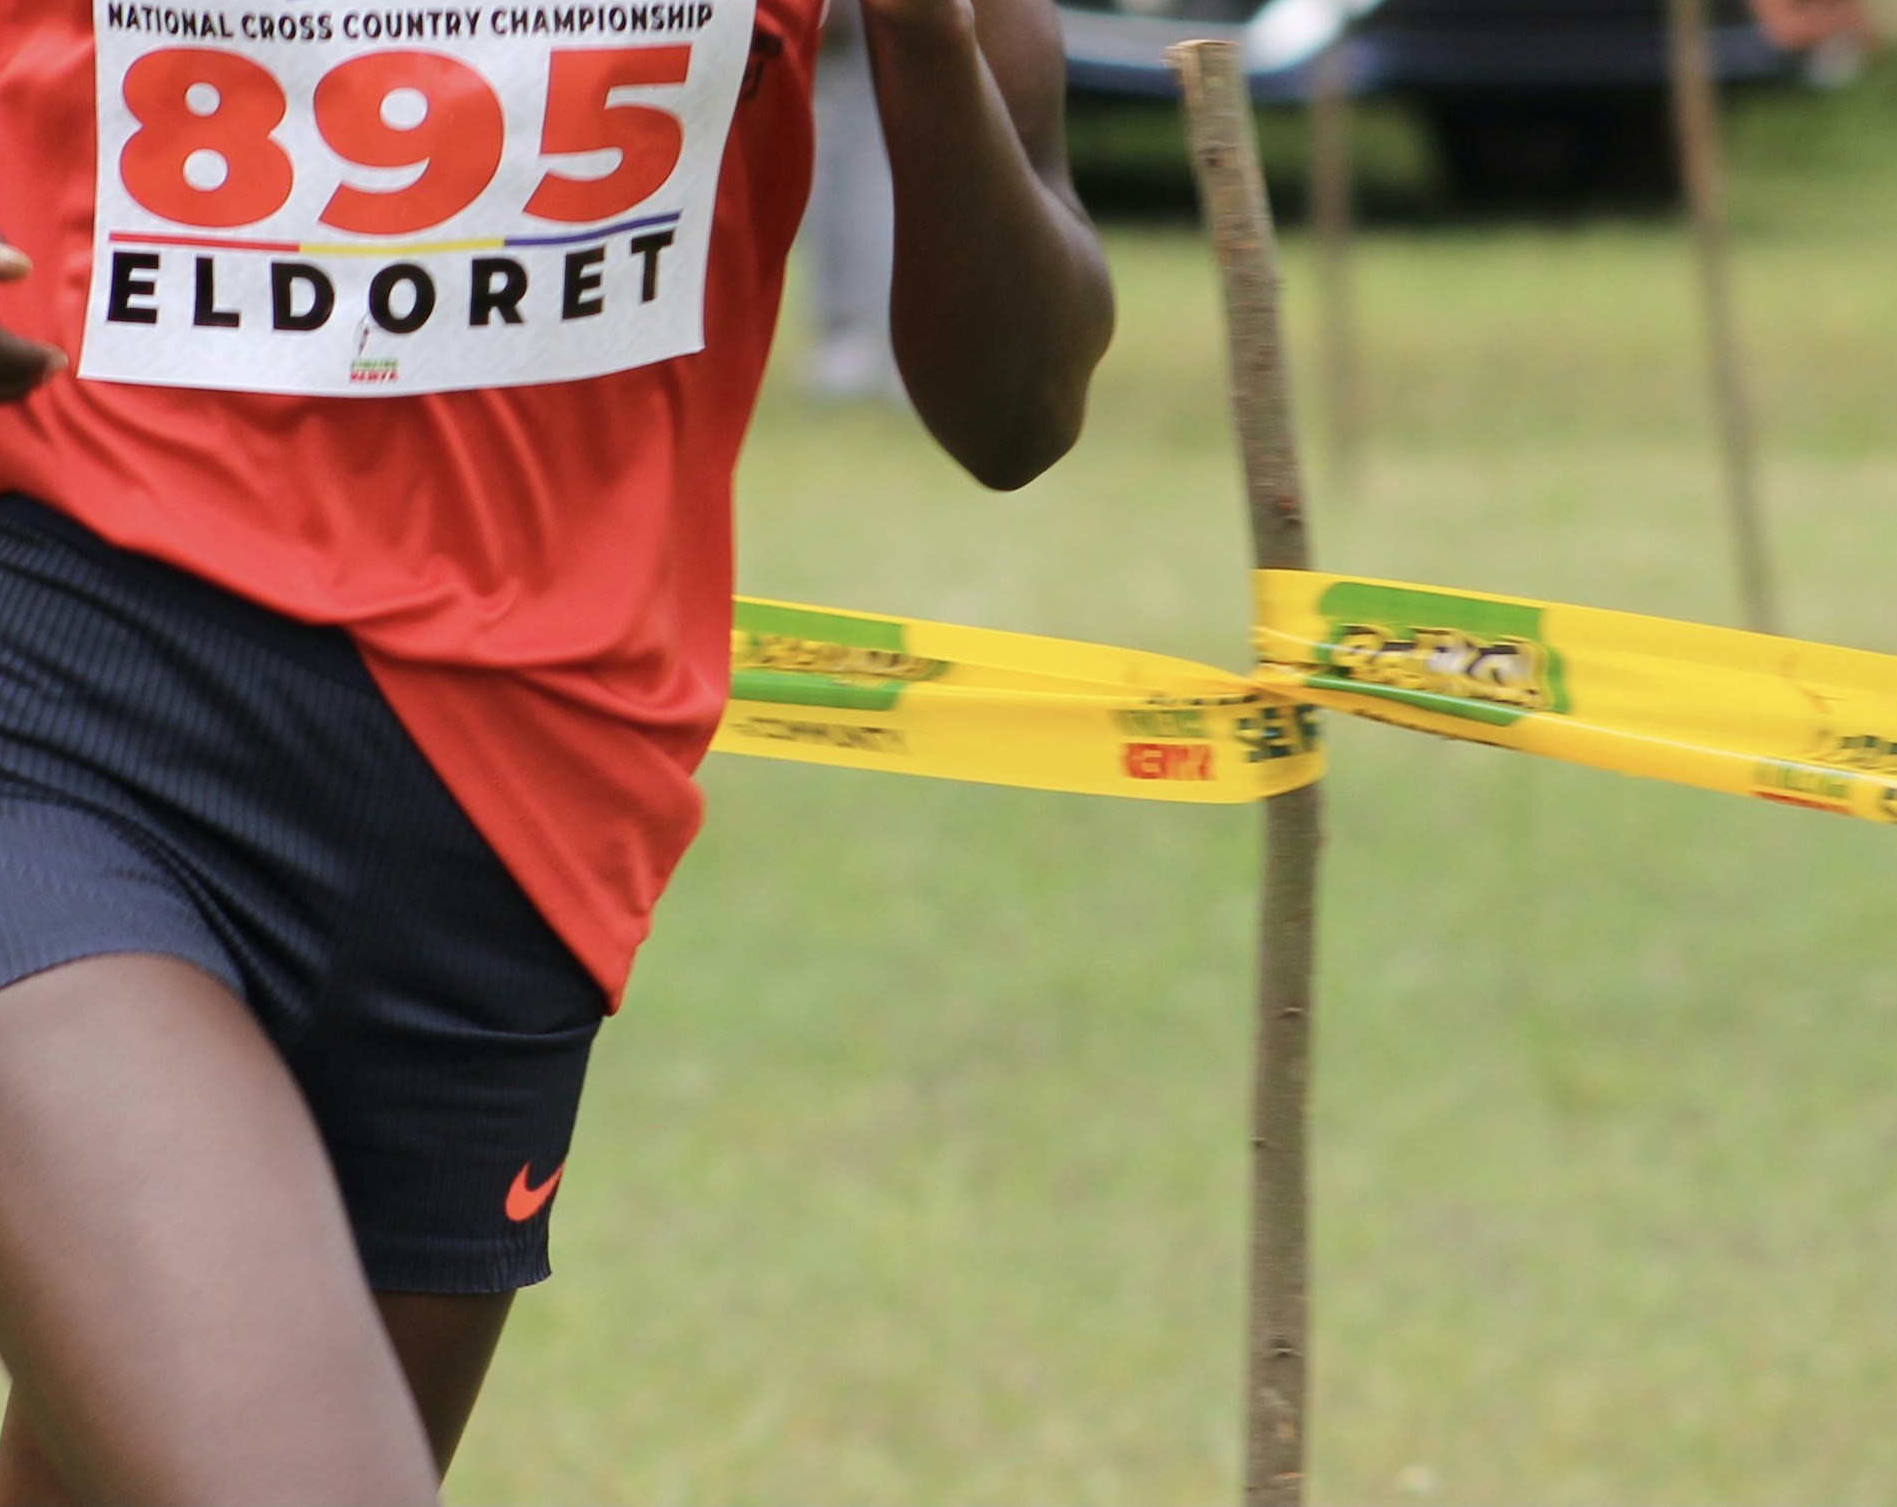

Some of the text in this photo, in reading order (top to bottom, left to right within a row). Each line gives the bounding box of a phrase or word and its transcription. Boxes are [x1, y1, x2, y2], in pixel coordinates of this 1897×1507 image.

[107, 2, 713, 41] NATIONAL CROSS COUNTRY CHAMPIONSHIP
[119, 43, 693, 235] 895
[106, 228, 677, 335] ELDORET
